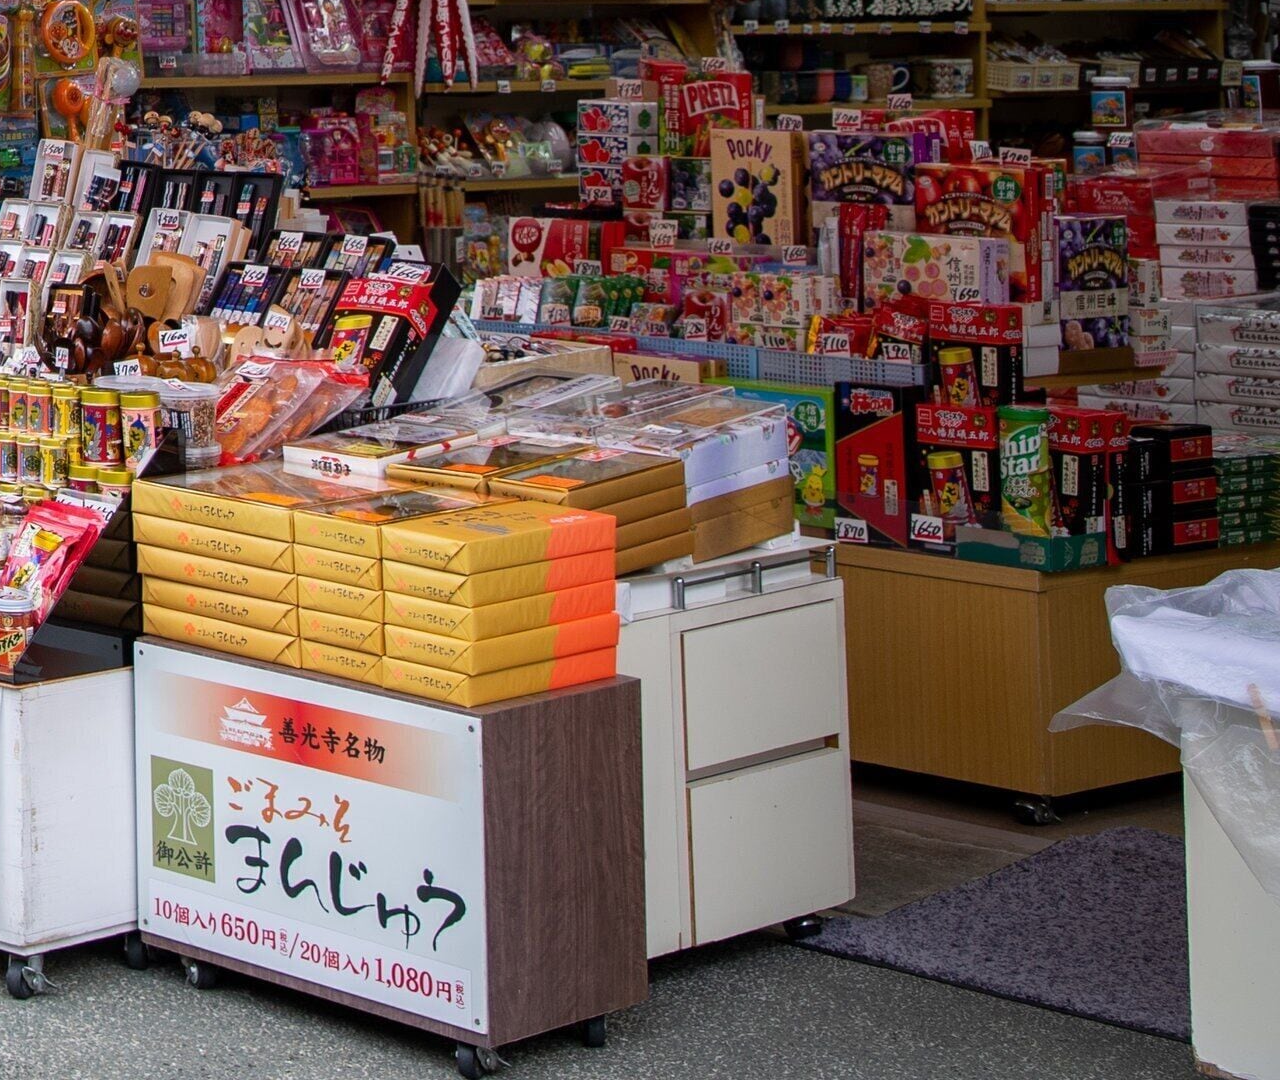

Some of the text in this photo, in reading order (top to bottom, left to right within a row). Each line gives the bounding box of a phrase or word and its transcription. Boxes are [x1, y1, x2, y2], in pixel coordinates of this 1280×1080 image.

[684, 82, 738, 115] PRETZ
[664, 108, 680, 151] 信州
[820, 162, 905, 196] カントリーマアム
[925, 198, 1012, 233] カントリーマアム
[1068, 248, 1125, 280] カントリーマアム
[1075, 293, 1117, 309] 信州巨峰
[277, 717, 386, 765] 善光寺名物
[227, 775, 353, 844] ごまみそ
[154, 839, 214, 877] 御公許
[225, 825, 467, 952] まんじゅう
